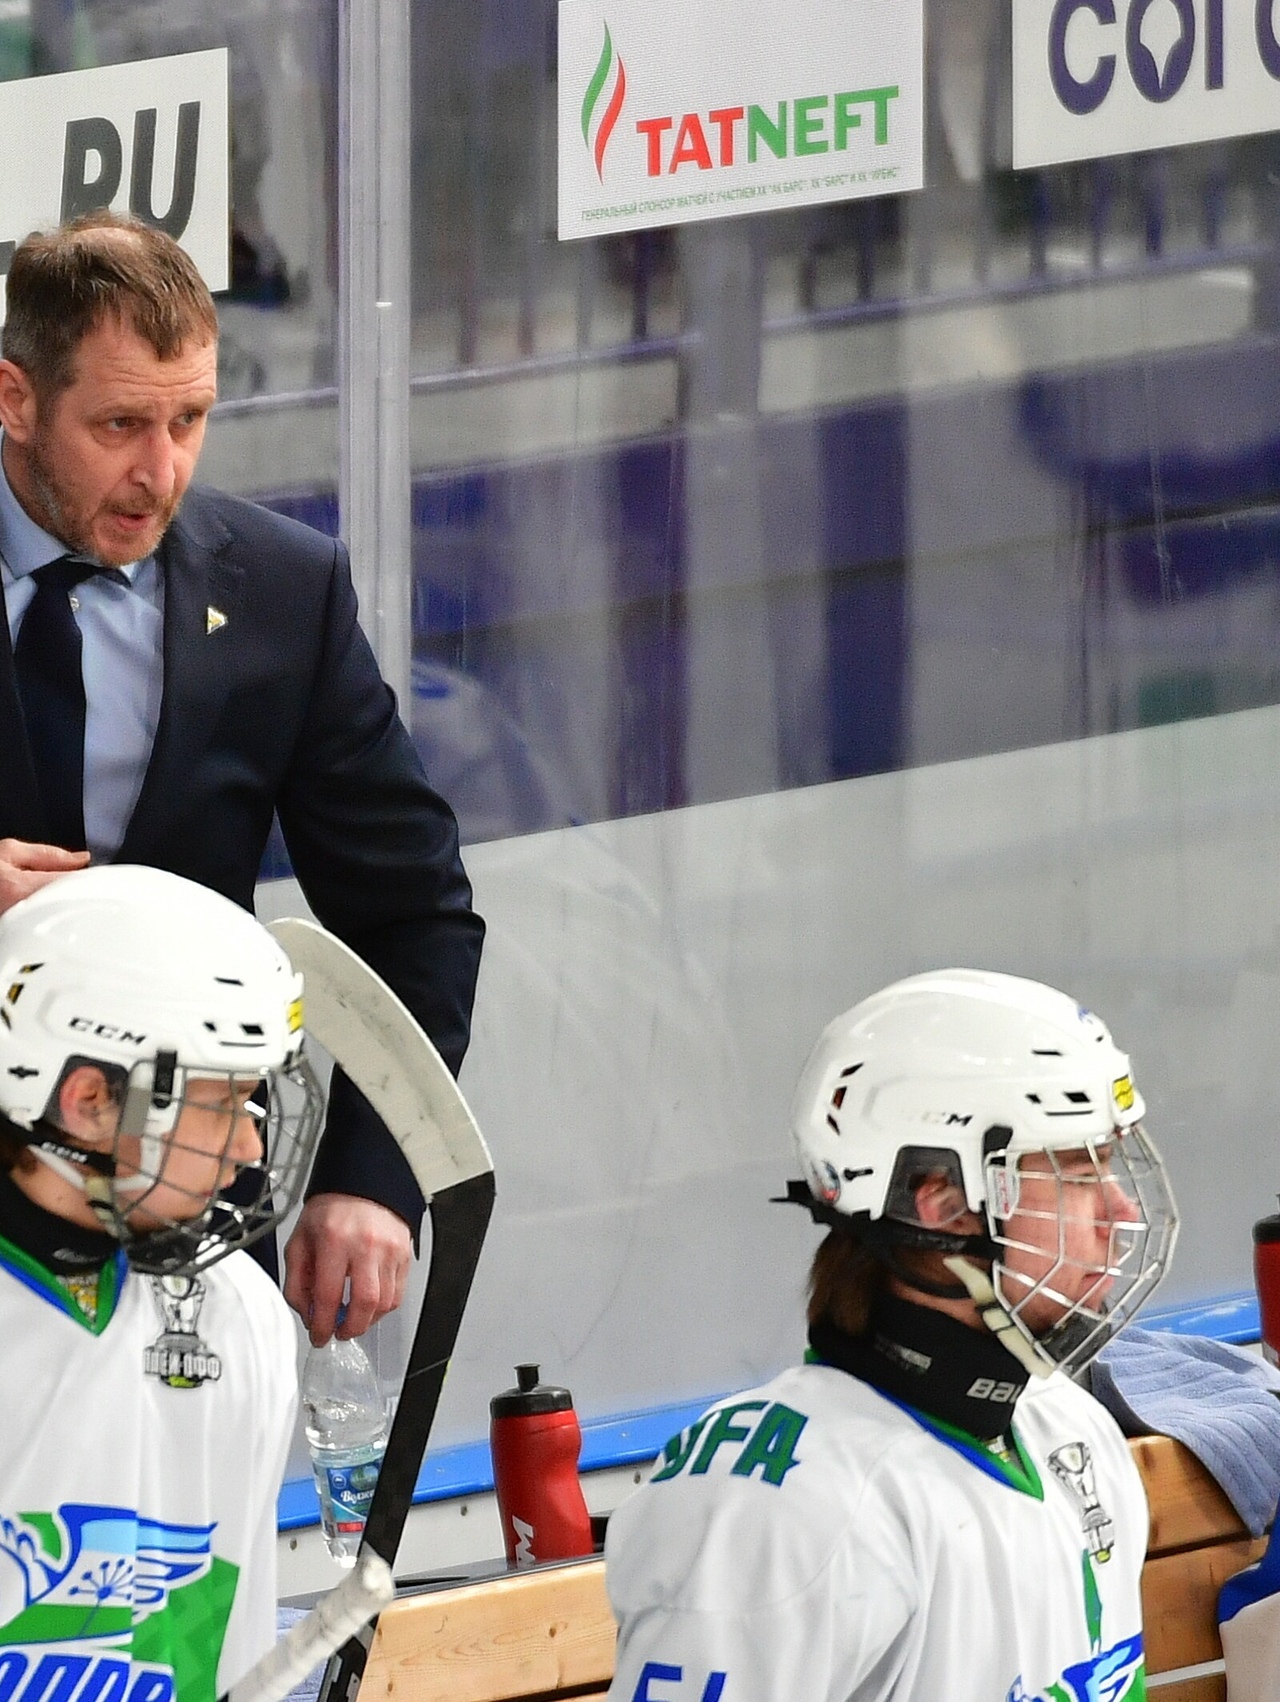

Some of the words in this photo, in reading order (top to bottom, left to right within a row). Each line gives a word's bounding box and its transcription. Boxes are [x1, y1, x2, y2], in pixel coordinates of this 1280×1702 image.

[636, 85, 899, 176] TATNEFT
[68, 1017, 146, 1045] CCM
[650, 1400, 808, 1487] UFA
